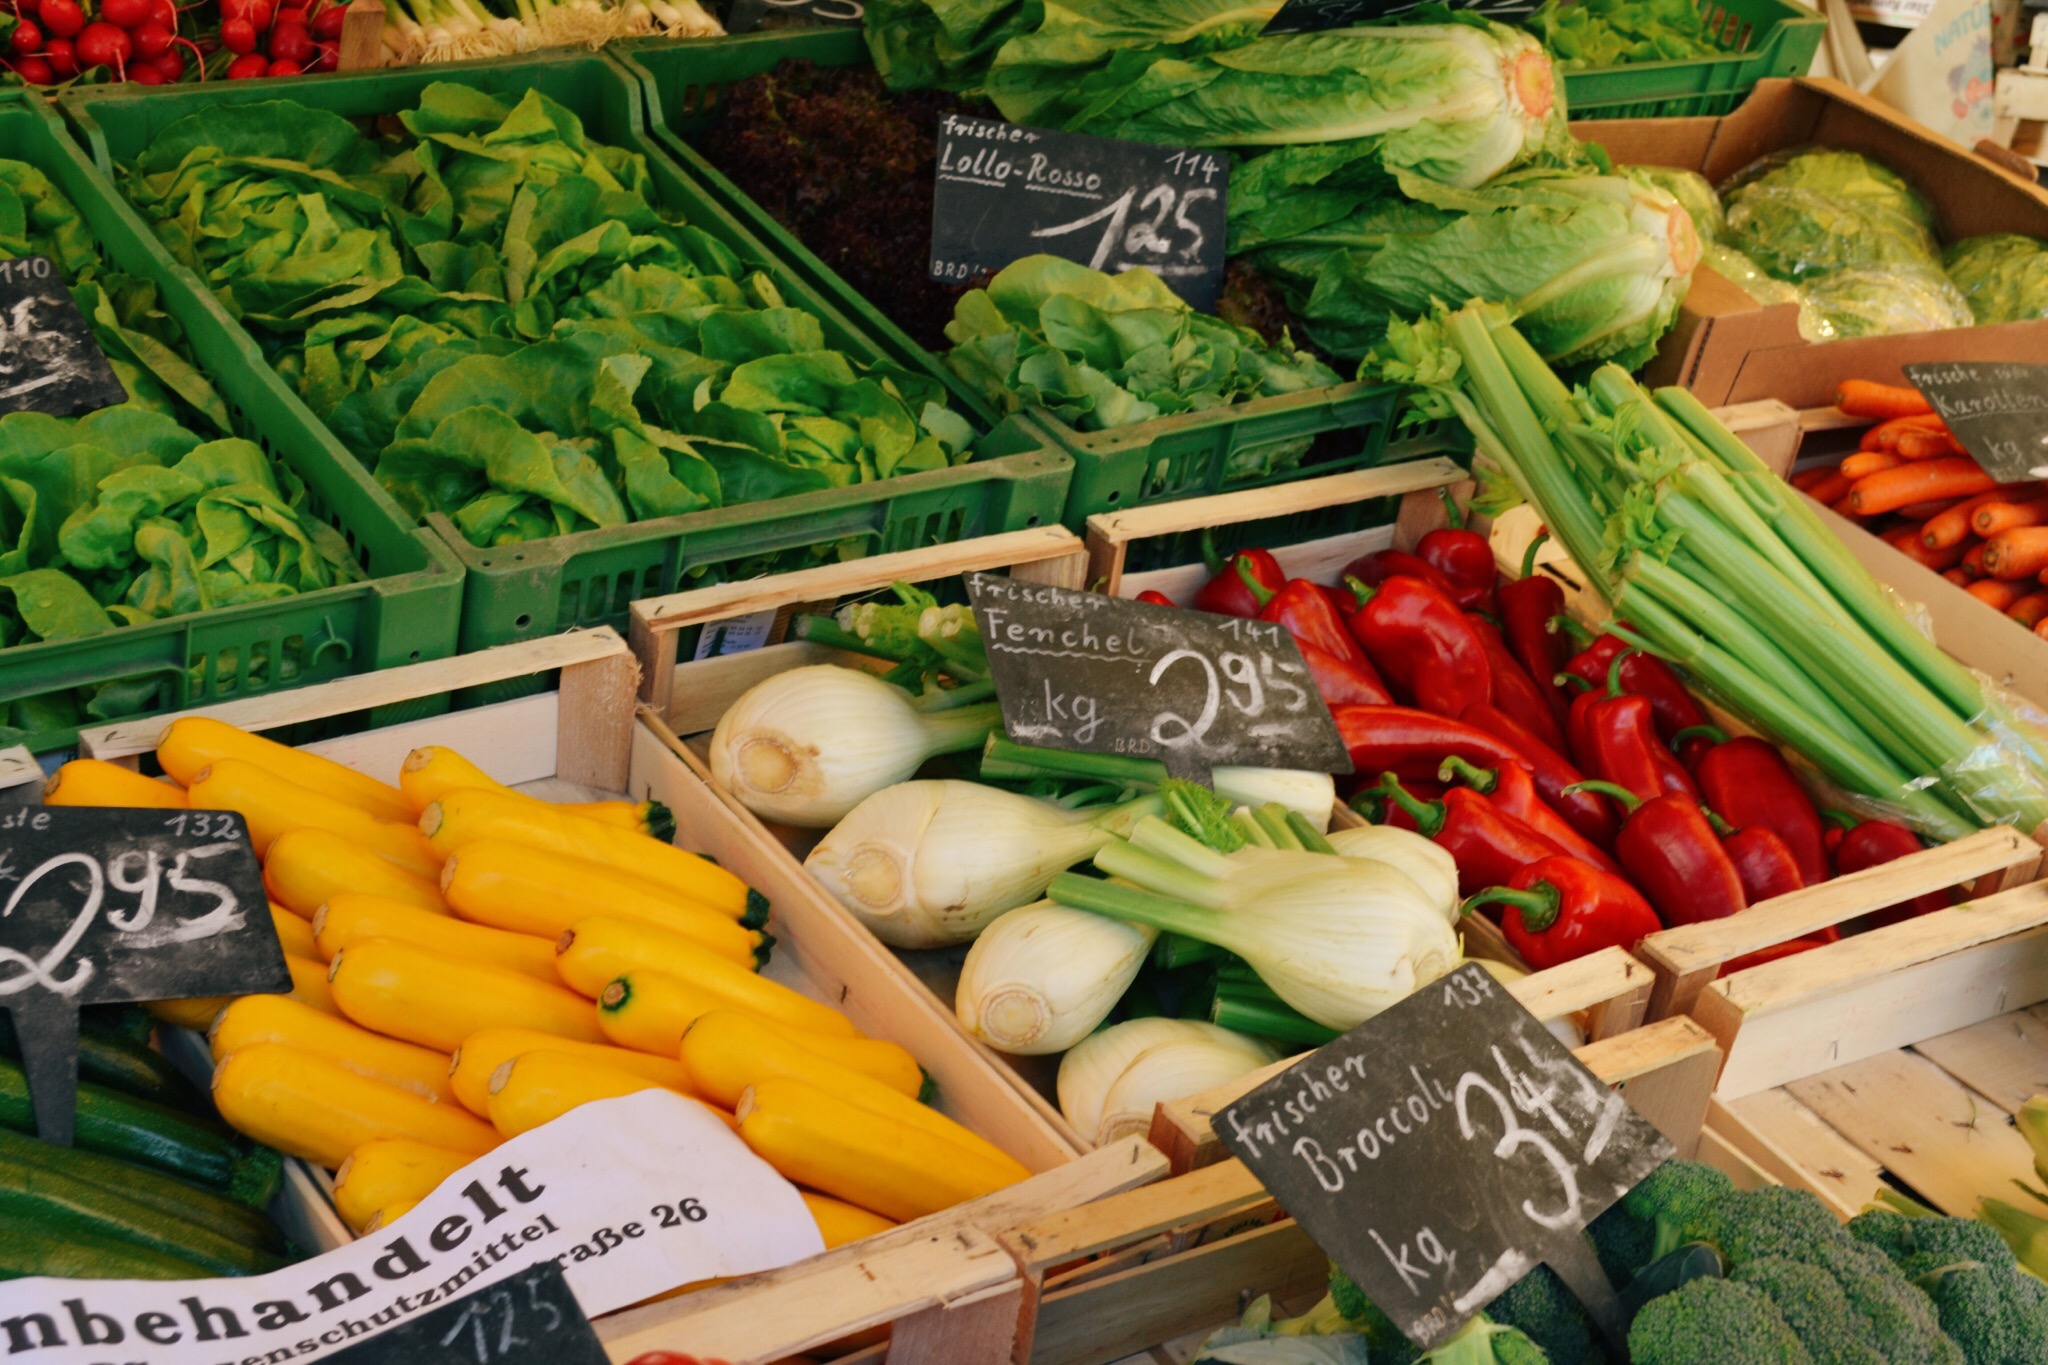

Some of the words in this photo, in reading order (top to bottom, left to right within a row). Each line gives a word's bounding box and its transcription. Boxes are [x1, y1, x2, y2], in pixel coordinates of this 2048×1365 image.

[942, 115, 1041, 144] frischer
[939, 142, 1101, 190] Lollo-Rosso
[1165, 152, 1219, 183] 114
[0, 257, 50, 284] 110
[933, 260, 968, 279] BRD
[1910, 363, 1979, 387] frische
[1982, 435, 2026, 466] kg
[969, 575, 1106, 611] frischer
[983, 608, 1143, 655] Fenchel
[1218, 618, 1279, 648] 141
[1044, 678, 1104, 744] kg
[1150, 650, 1308, 757] 295
[164, 814, 241, 840] 132
[1443, 968, 1493, 1010] 137
[1228, 1053, 1367, 1159] frischer
[1292, 1065, 1455, 1192] Broccoli
[650, 1197, 708, 1229] 26
[0, 1165, 546, 1355] nbehandelt
[1368, 1226, 1457, 1297] kg
[226, 1213, 559, 1365] enschutzmittel
[440, 1278, 561, 1364] 125
